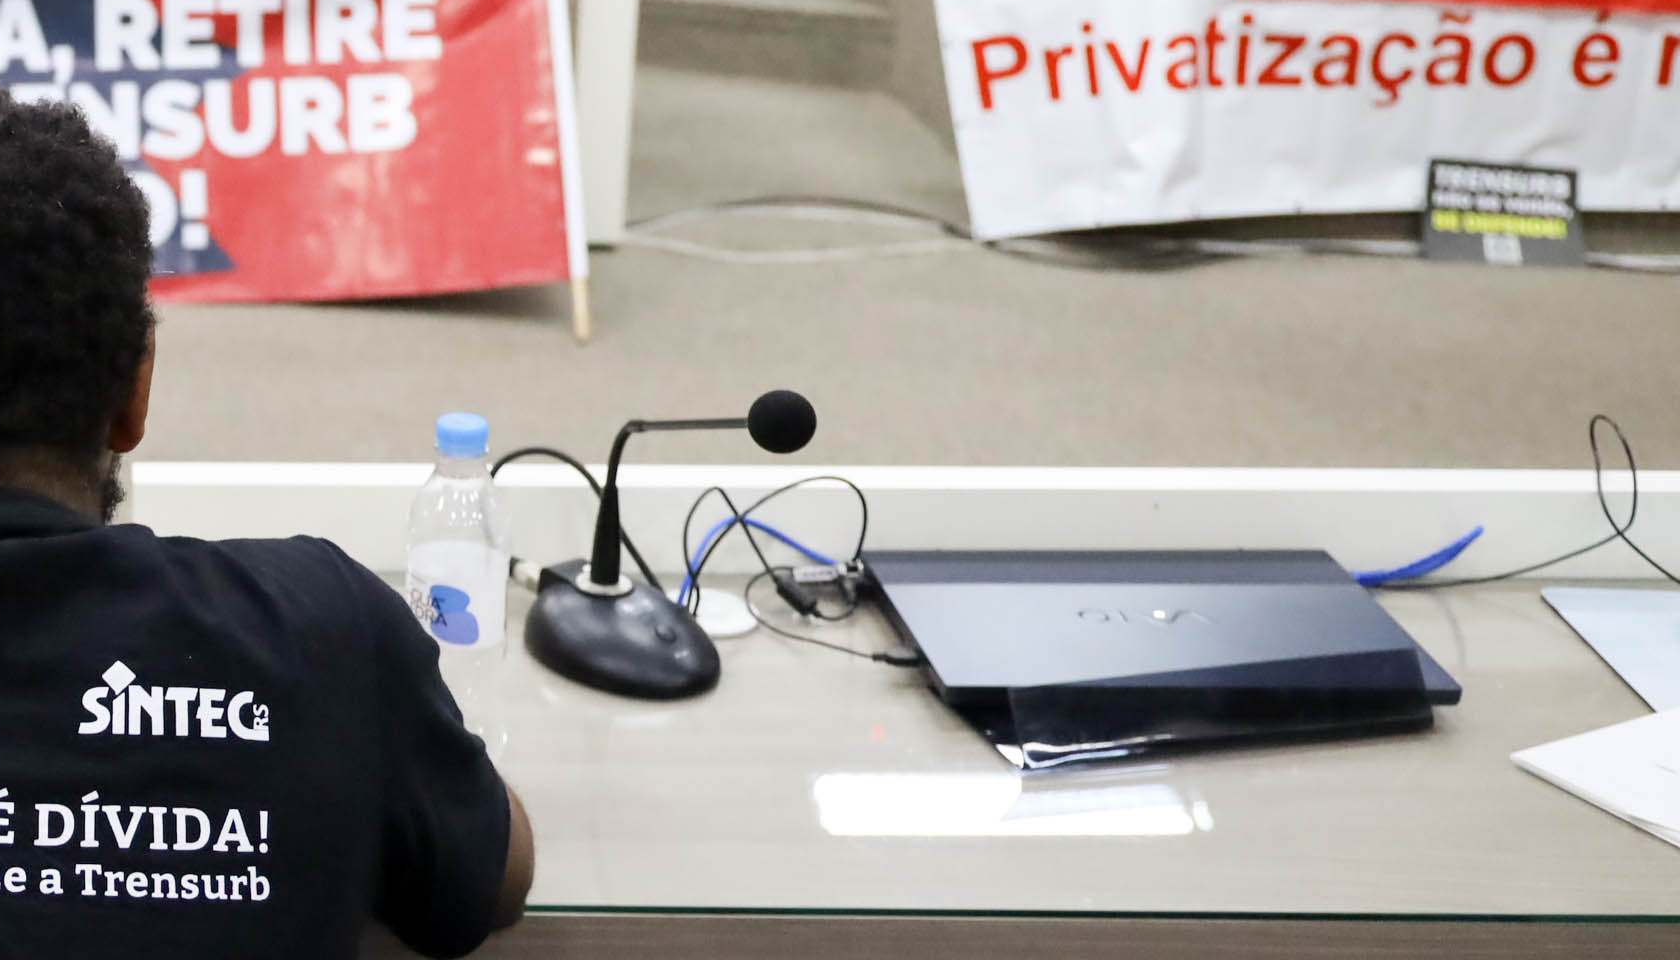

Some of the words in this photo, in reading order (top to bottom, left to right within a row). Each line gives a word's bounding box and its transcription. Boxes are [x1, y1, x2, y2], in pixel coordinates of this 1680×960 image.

[972, 14, 1536, 109] Privatização
[1572, 12, 1622, 88] é
[33, 790, 269, 854] DÍVIDA!
[39, 867, 64, 895] a
[75, 863, 270, 902] Trensurb
